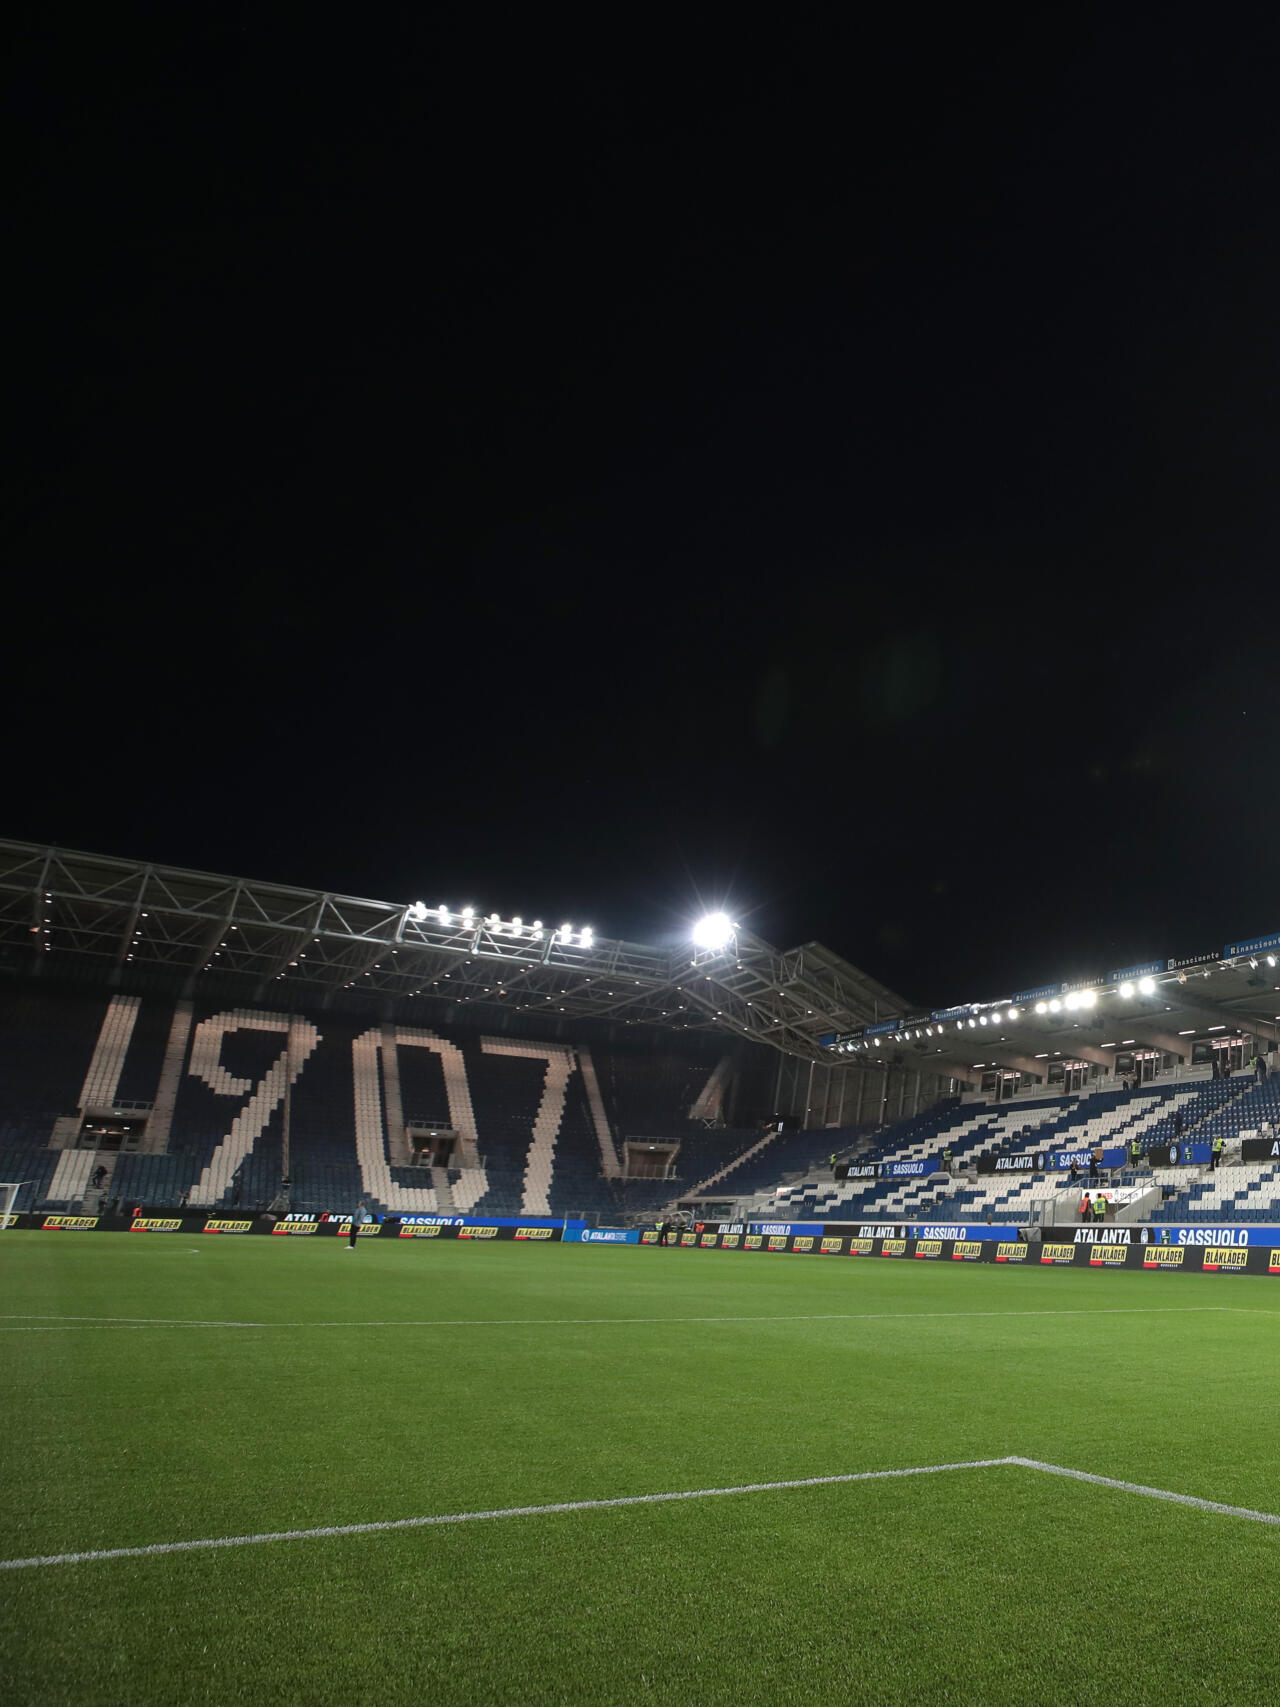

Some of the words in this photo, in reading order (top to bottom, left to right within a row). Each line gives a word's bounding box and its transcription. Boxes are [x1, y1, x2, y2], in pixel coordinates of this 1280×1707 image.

[47, 994, 577, 1217] 1907
[847, 1166, 875, 1178] ATALANTA
[892, 1163, 924, 1175] SASSUOLO
[995, 1156, 1033, 1170] ATALANTA
[859, 1226, 895, 1238] ATALANTA
[923, 1227, 967, 1240] SASSUOLO
[1074, 1229, 1131, 1244] ATALANTA
[1178, 1229, 1249, 1246] SASSUOLO
[1146, 1248, 1182, 1263] BLÅKLÄDER
[1206, 1249, 1246, 1265] BLÅKLÄDER
